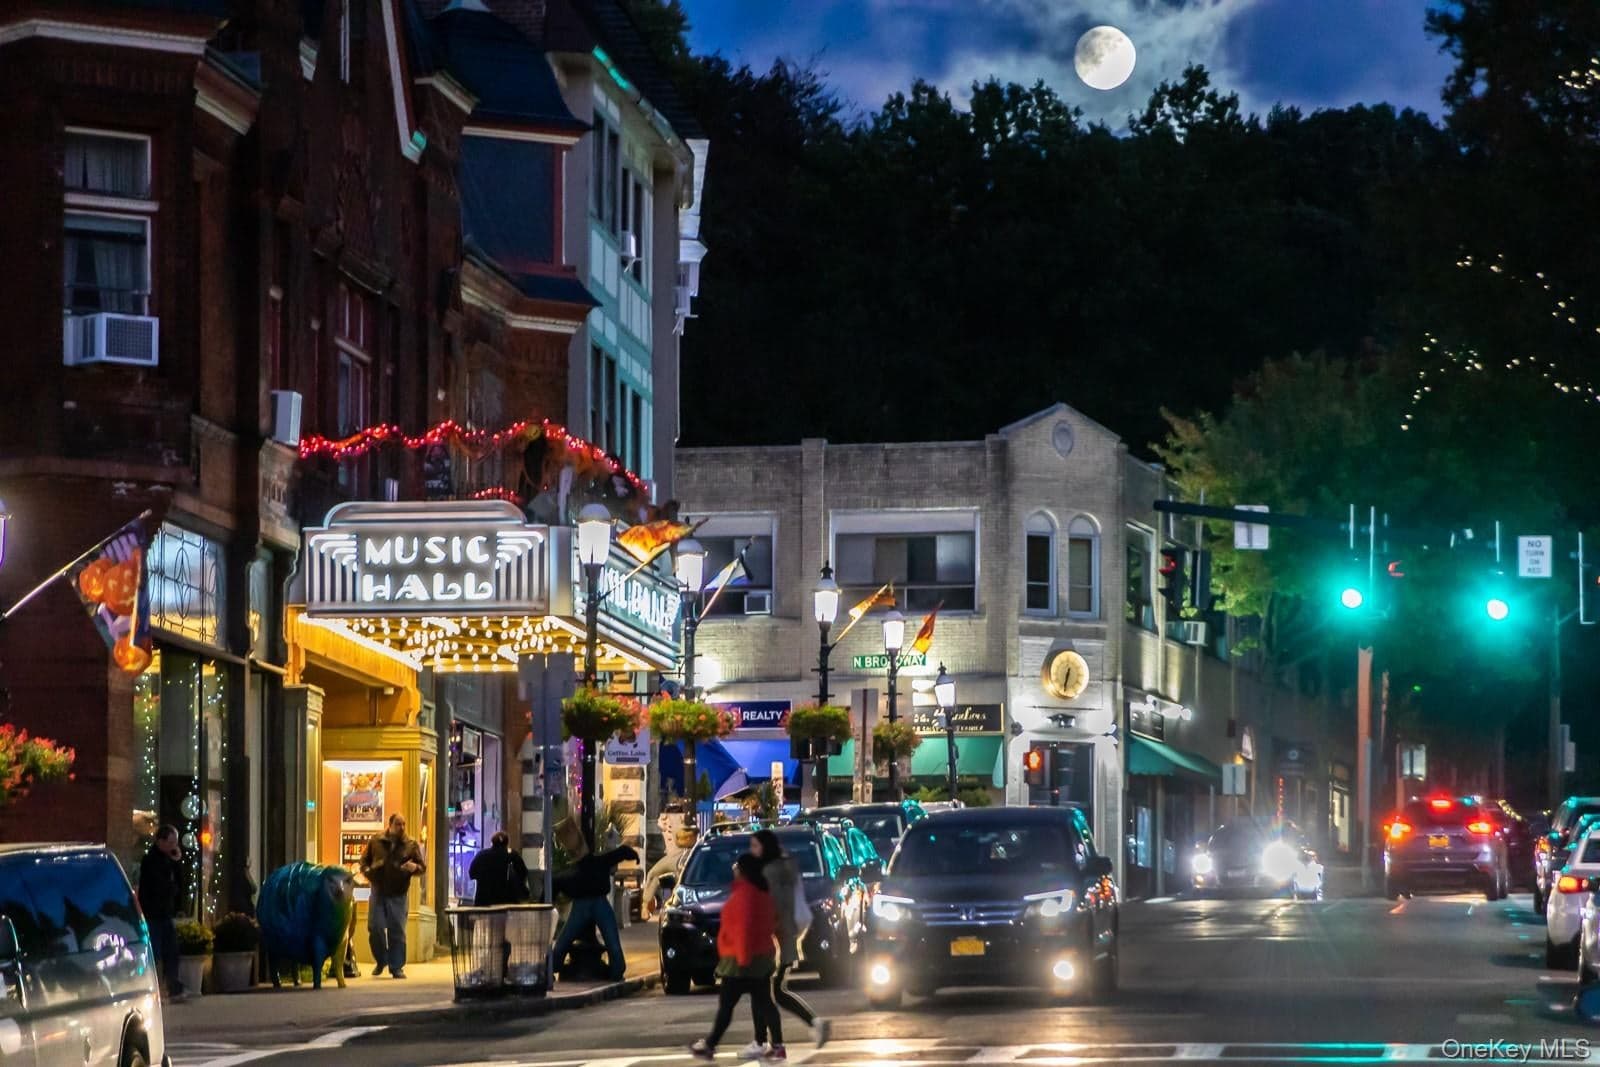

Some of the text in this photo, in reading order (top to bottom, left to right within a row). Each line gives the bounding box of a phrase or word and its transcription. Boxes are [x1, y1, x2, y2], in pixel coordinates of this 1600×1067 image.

[365, 535, 490, 565] MUSIC
[1527, 540, 1542, 548] NO
[362, 572, 493, 602] HALL
[853, 655, 925, 668] N BRODWAY
[742, 711, 783, 721] REALTY
